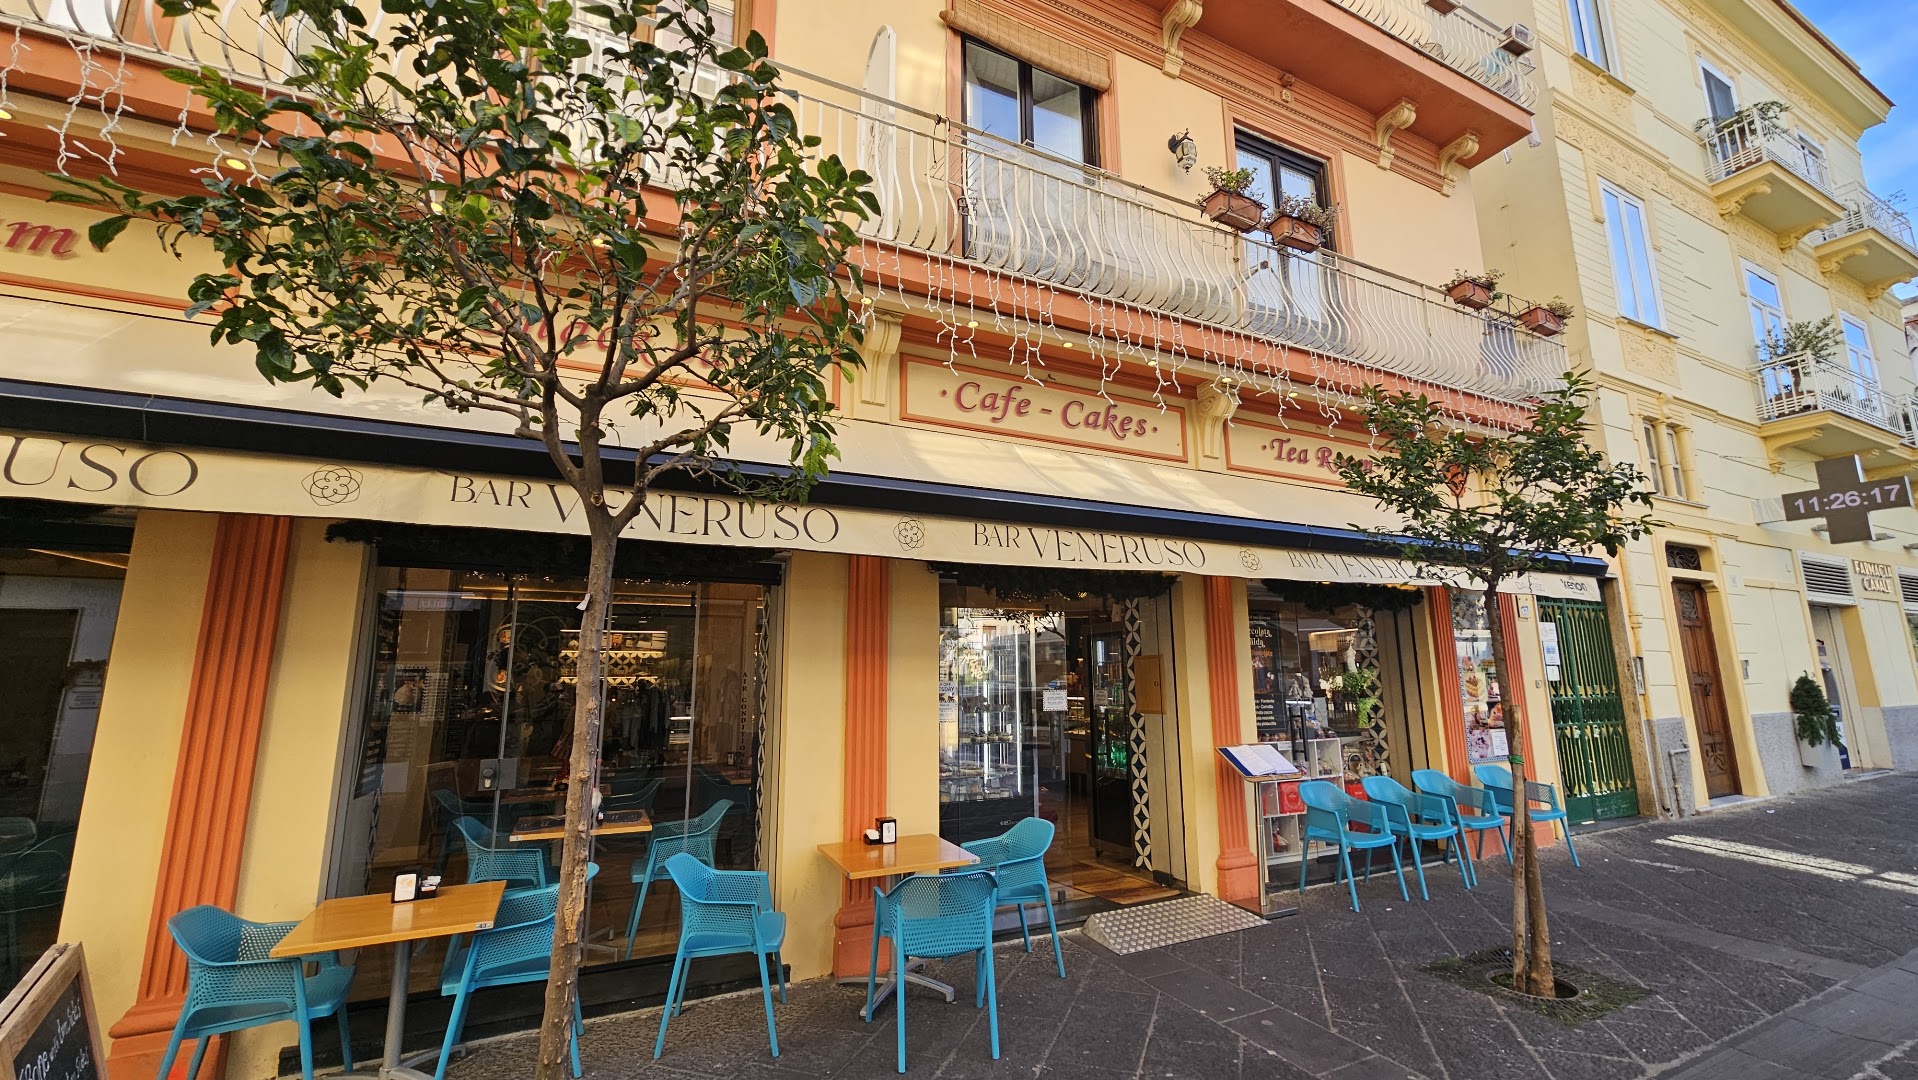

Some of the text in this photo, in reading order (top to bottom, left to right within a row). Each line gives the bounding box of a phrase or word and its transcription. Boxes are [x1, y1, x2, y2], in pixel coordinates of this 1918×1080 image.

[954, 381, 1032, 423] Cafe
[1060, 400, 1148, 440] Cakes
[1270, 438, 1374, 474] Tea Rm
[450, 475, 531, 509] BAR
[1794, 484, 1901, 514] 11:26:17
[973, 523, 1206, 569] BAR VENERUSO
[1286, 551, 1323, 570] BAR
[1853, 560, 1893, 578] FARMACIA
